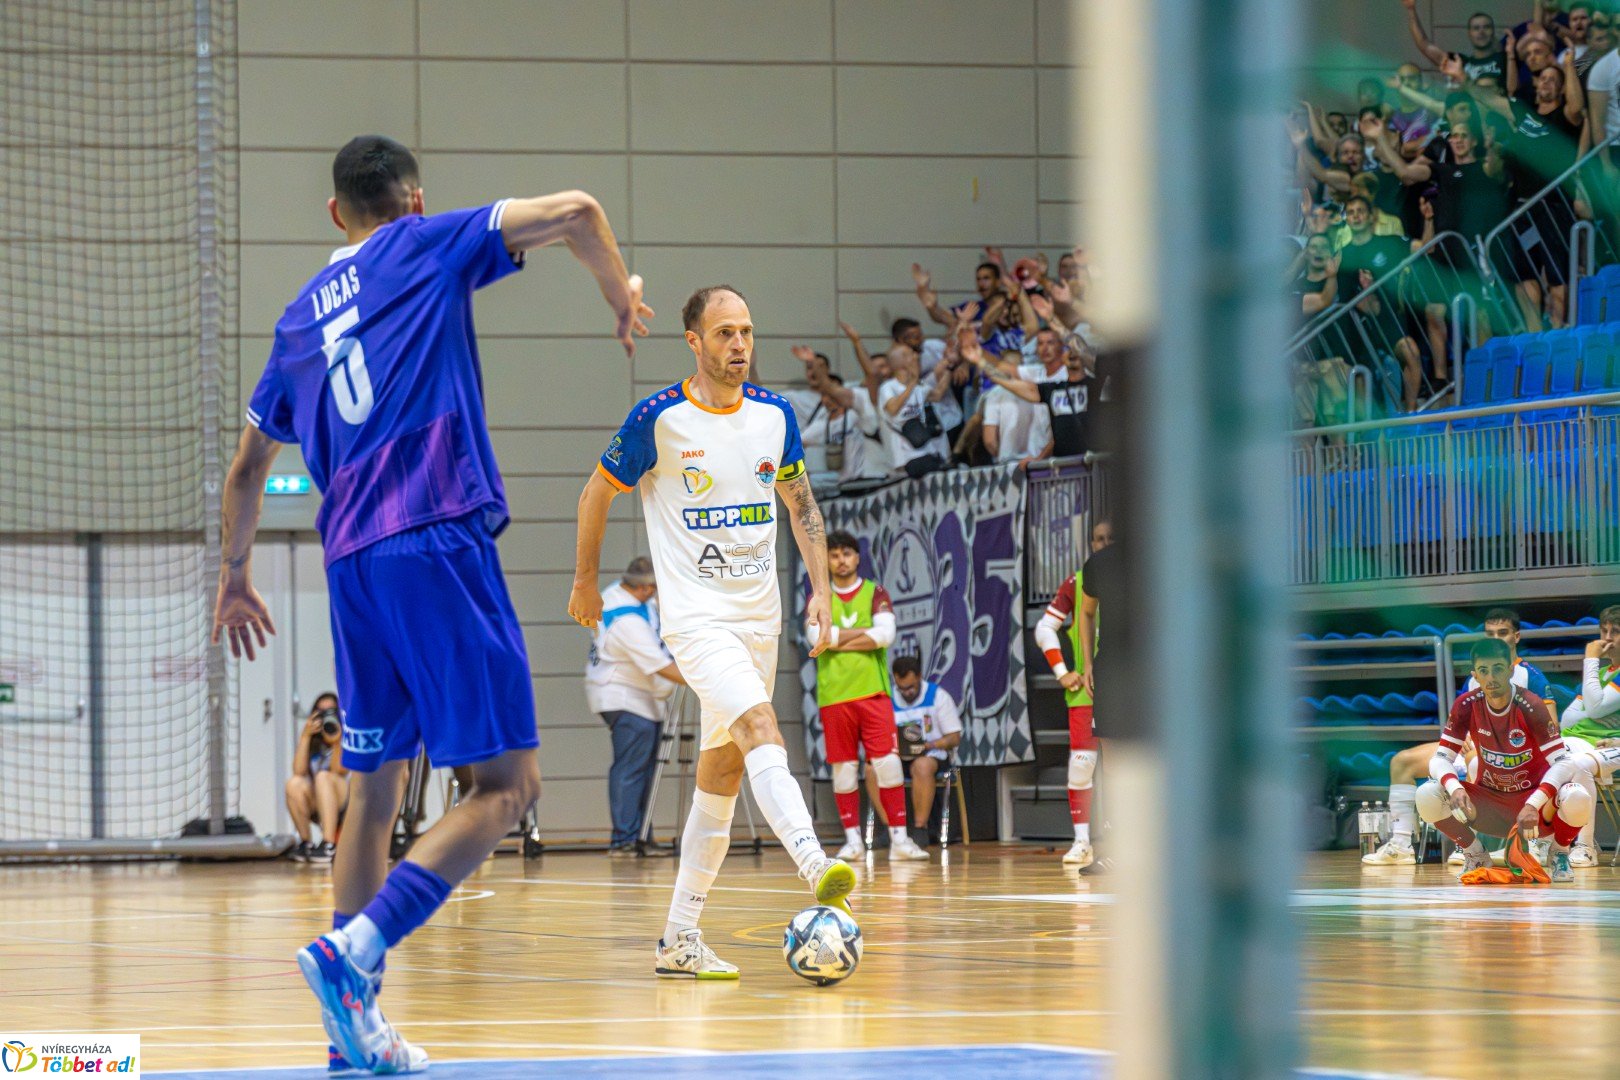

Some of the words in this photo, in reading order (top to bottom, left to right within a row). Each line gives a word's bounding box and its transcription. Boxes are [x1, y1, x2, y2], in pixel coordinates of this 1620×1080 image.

[311, 264, 361, 321] LUCAS
[320, 304, 375, 425] 5
[681, 449, 705, 459] JAKO
